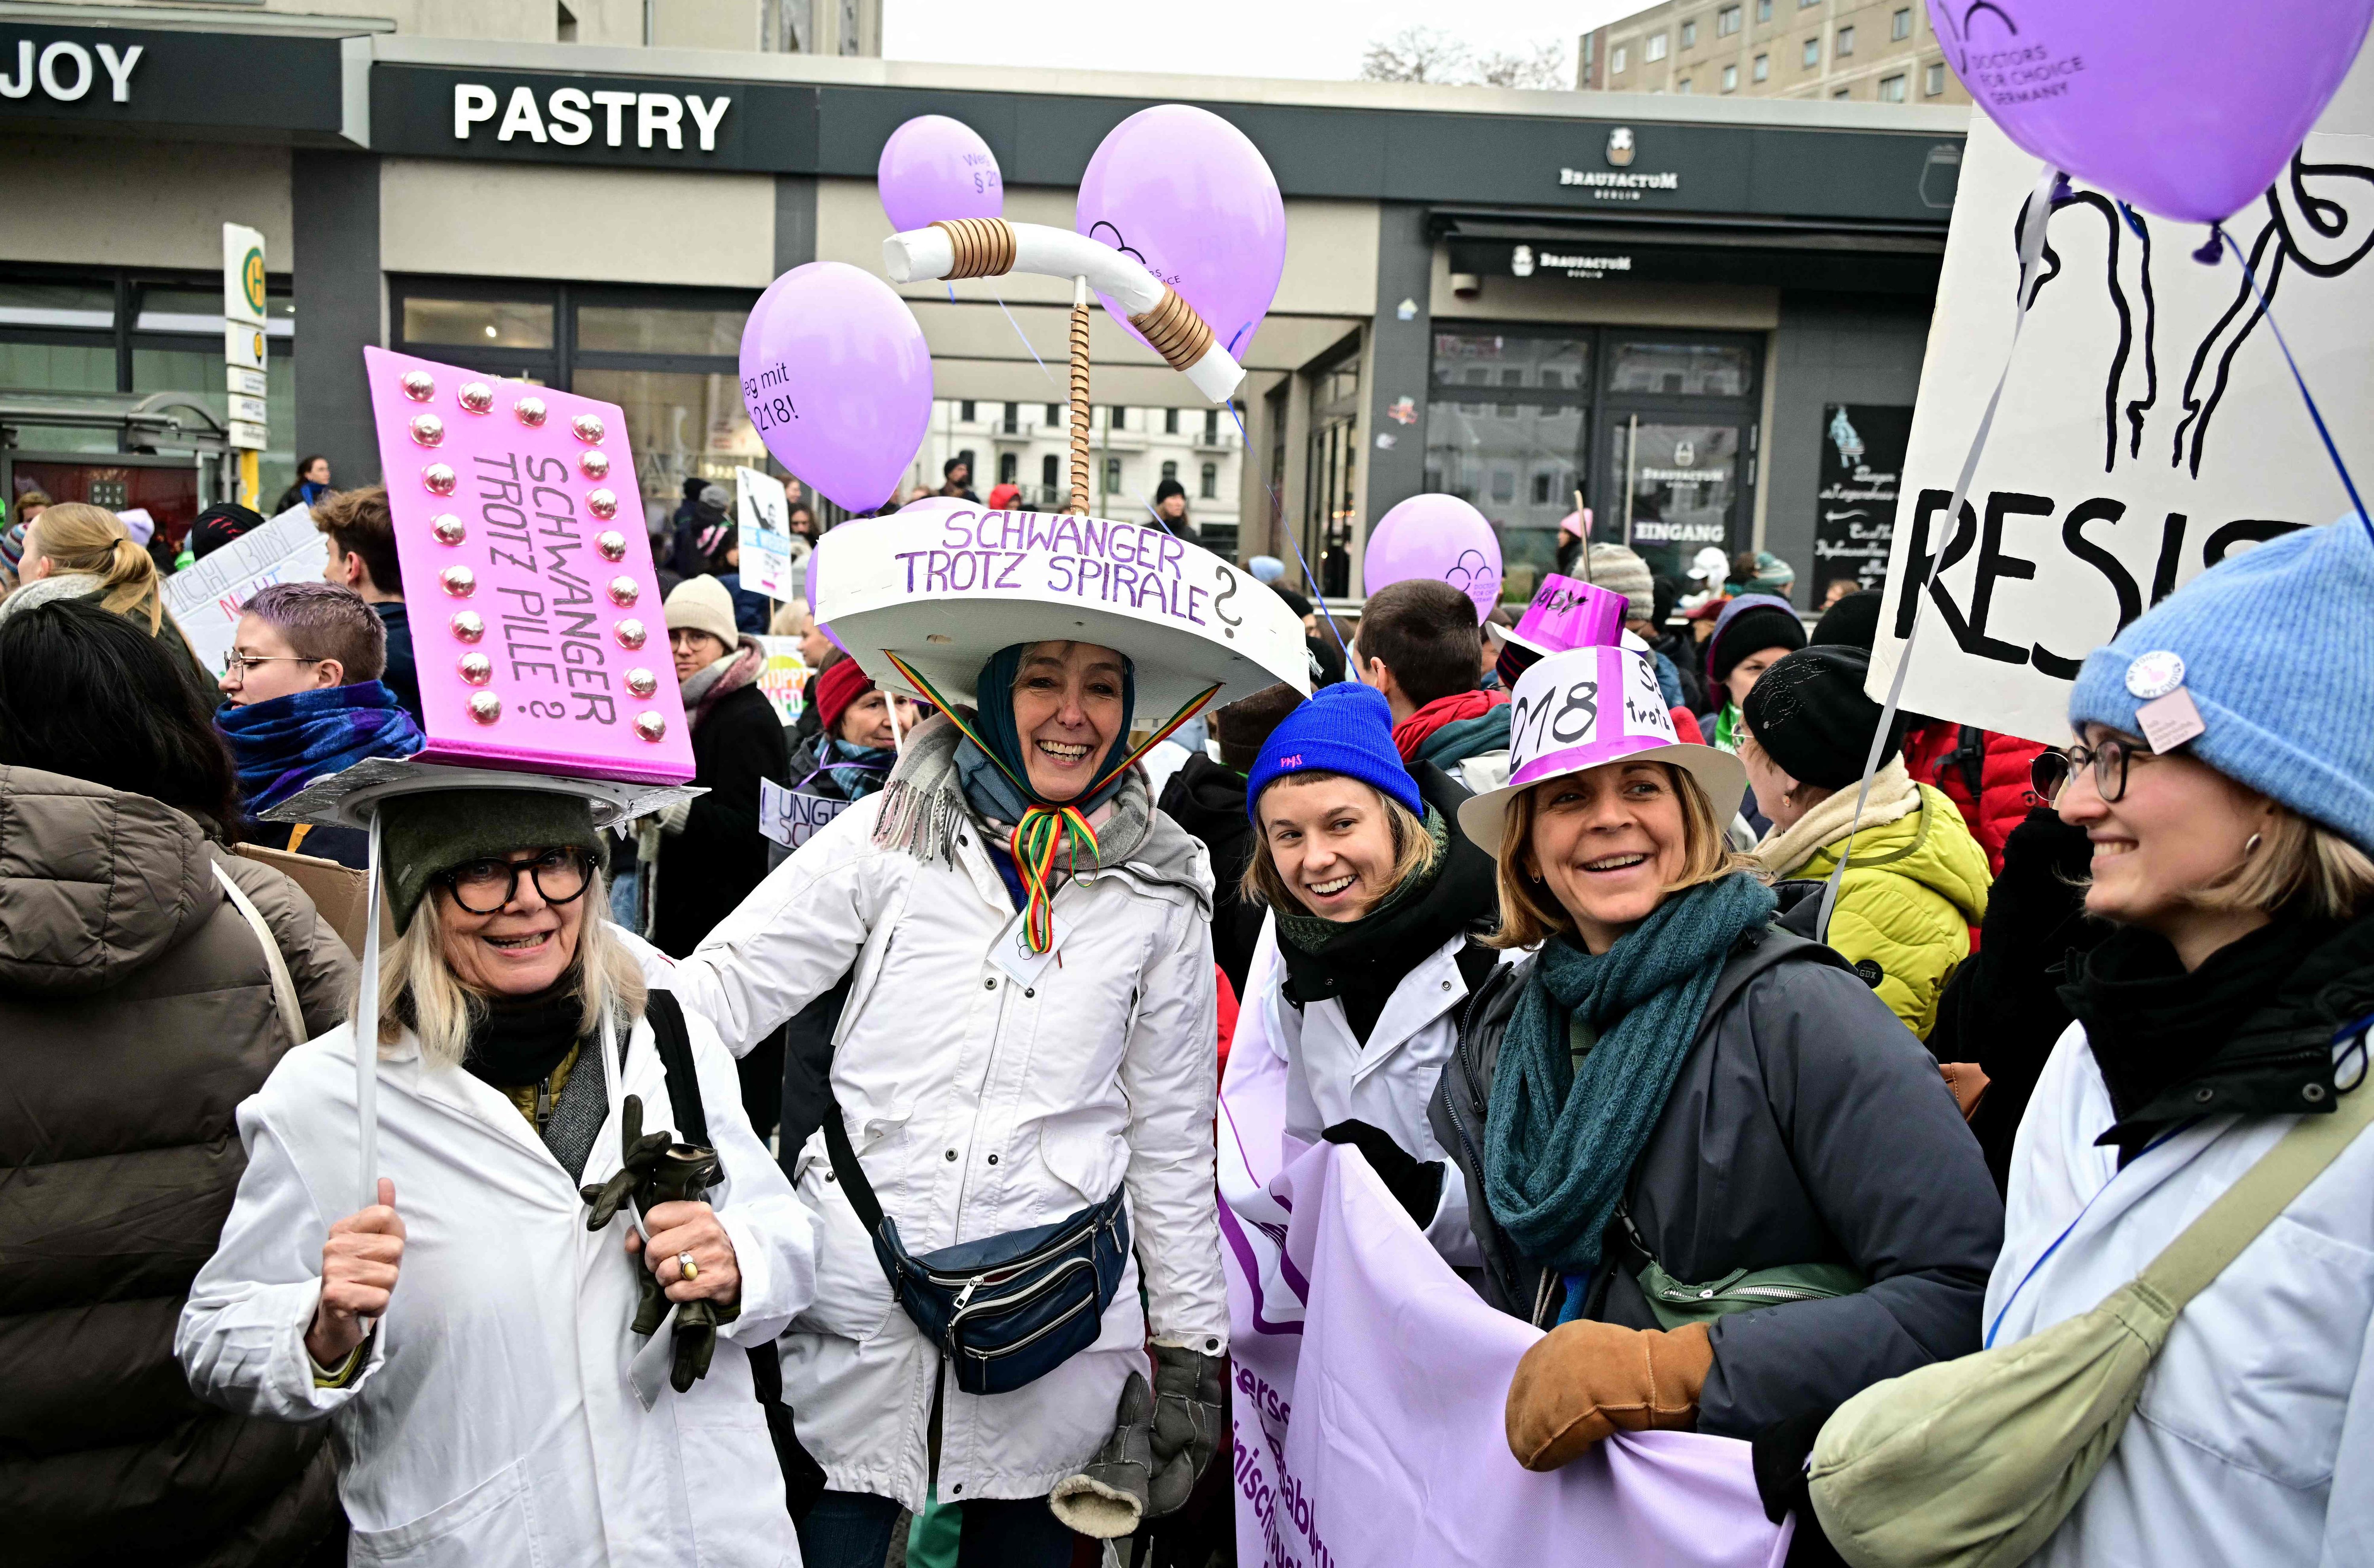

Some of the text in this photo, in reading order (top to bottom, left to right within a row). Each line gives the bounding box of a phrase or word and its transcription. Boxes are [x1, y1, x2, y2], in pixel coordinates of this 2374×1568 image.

[454, 83, 731, 151] PASTRY
[761, 362, 790, 389] mit
[473, 452, 538, 573] TROTZ
[1635, 522, 1725, 542] EINGANG
[232, 522, 292, 576] BIN
[942, 510, 1185, 580] SCHWANGER
[525, 454, 616, 725] SCHWANGER
[895, 550, 1028, 593] TROTZ
[757, 668, 808, 689] TOPPT
[1509, 681, 1598, 775] 218
[1626, 696, 1670, 731] trotz
[1280, 754, 1303, 768] PMS
[779, 789, 852, 826] UNGE
[1859, 969, 1876, 979] GDX
